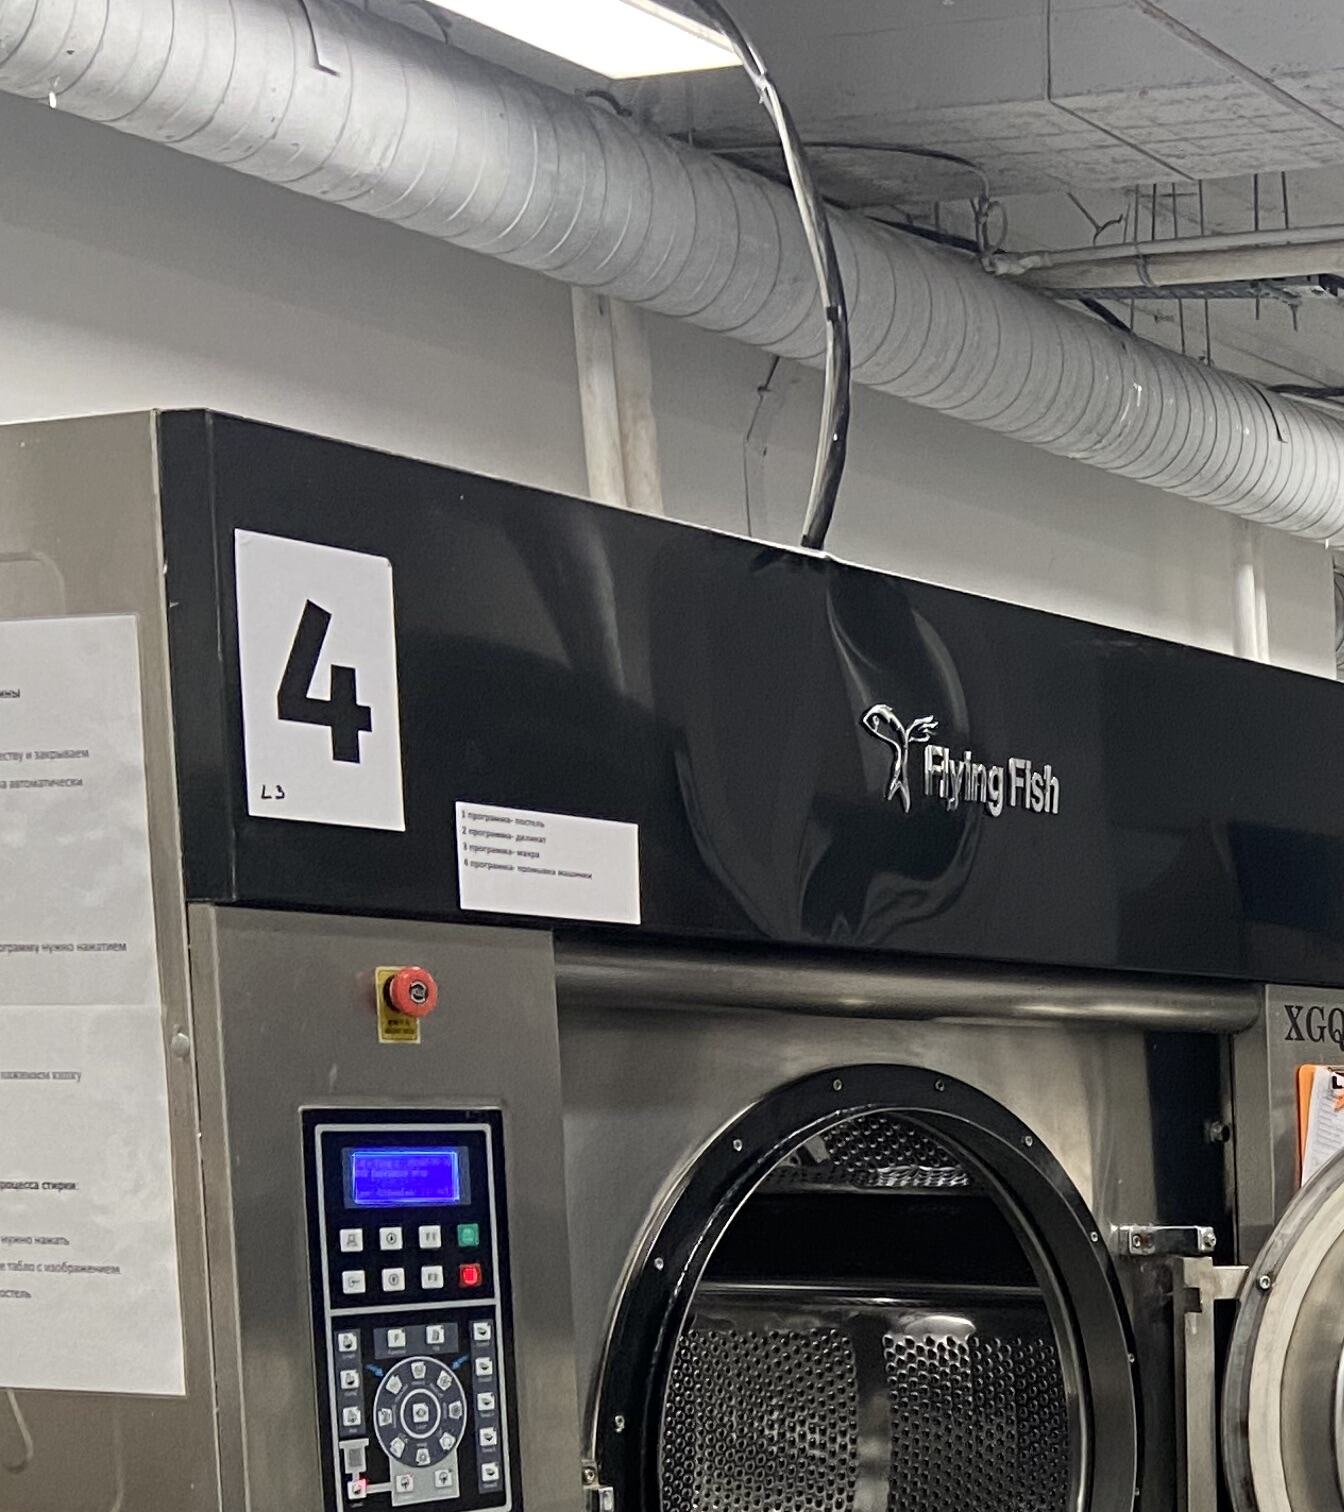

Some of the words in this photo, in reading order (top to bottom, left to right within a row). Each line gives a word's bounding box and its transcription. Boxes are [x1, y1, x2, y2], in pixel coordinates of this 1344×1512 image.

[277, 599, 372, 764] 4
[924, 744, 1004, 817] Flying
[1008, 757, 1060, 815] Fish
